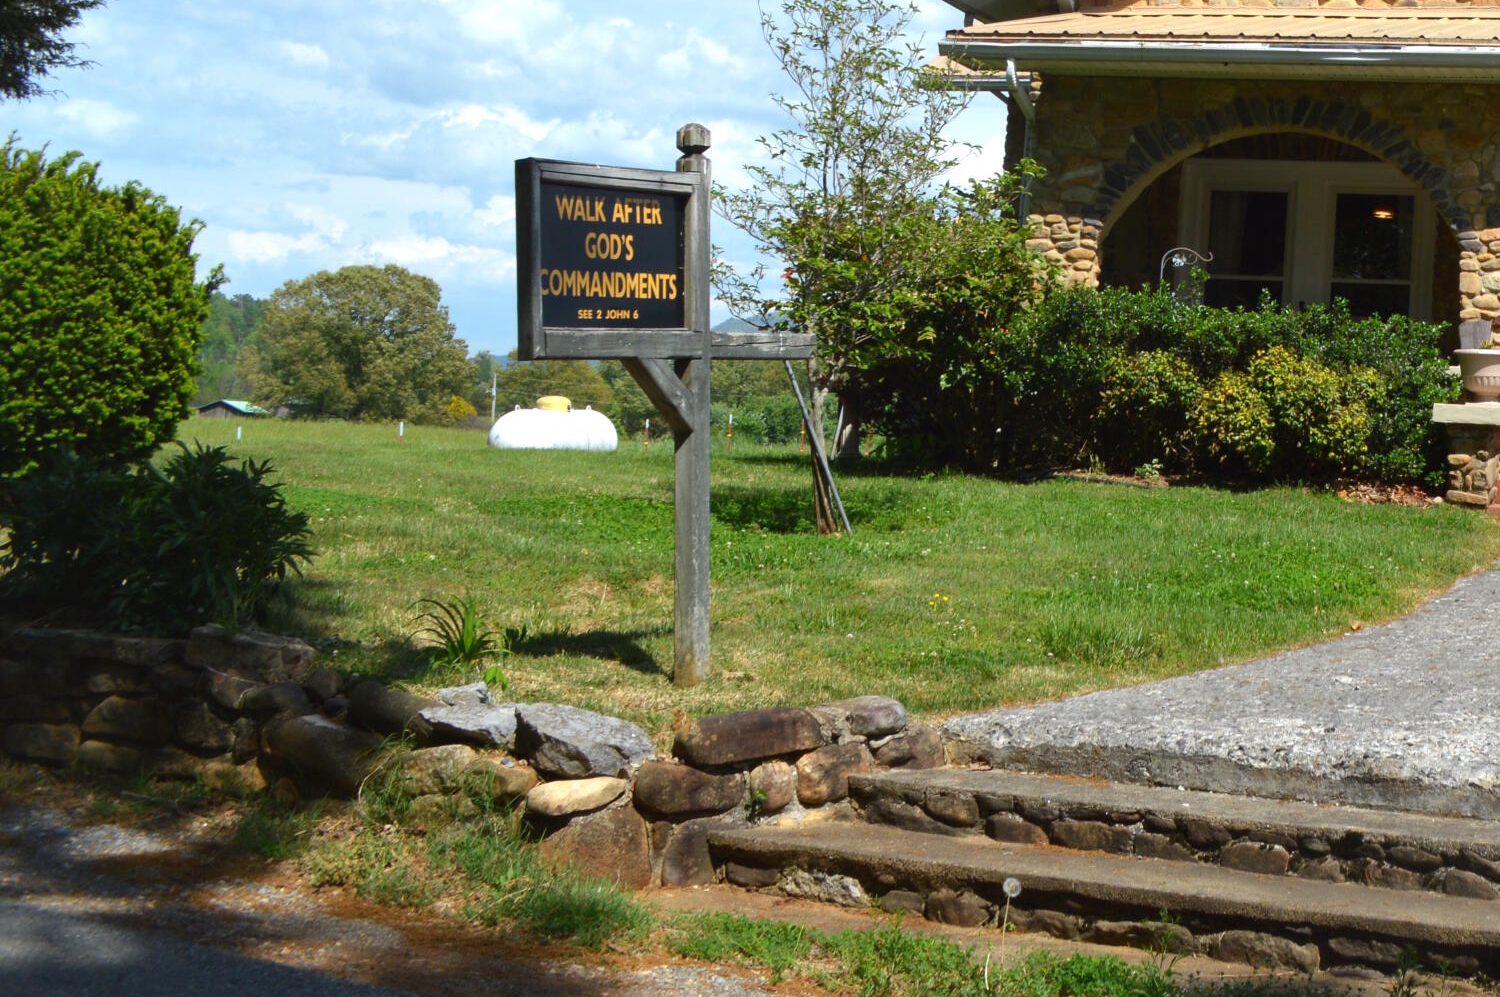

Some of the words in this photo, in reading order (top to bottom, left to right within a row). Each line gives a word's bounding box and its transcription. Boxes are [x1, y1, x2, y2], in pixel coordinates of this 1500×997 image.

[555, 194, 607, 222] WALK
[612, 197, 662, 224] AFTER
[584, 232, 634, 261] GOD'S
[540, 269, 677, 299] COMMANDMENTS
[577, 309, 593, 319] SEE
[596, 309, 602, 319] 2
[605, 309, 630, 319] JOHN
[632, 309, 639, 319] 6
